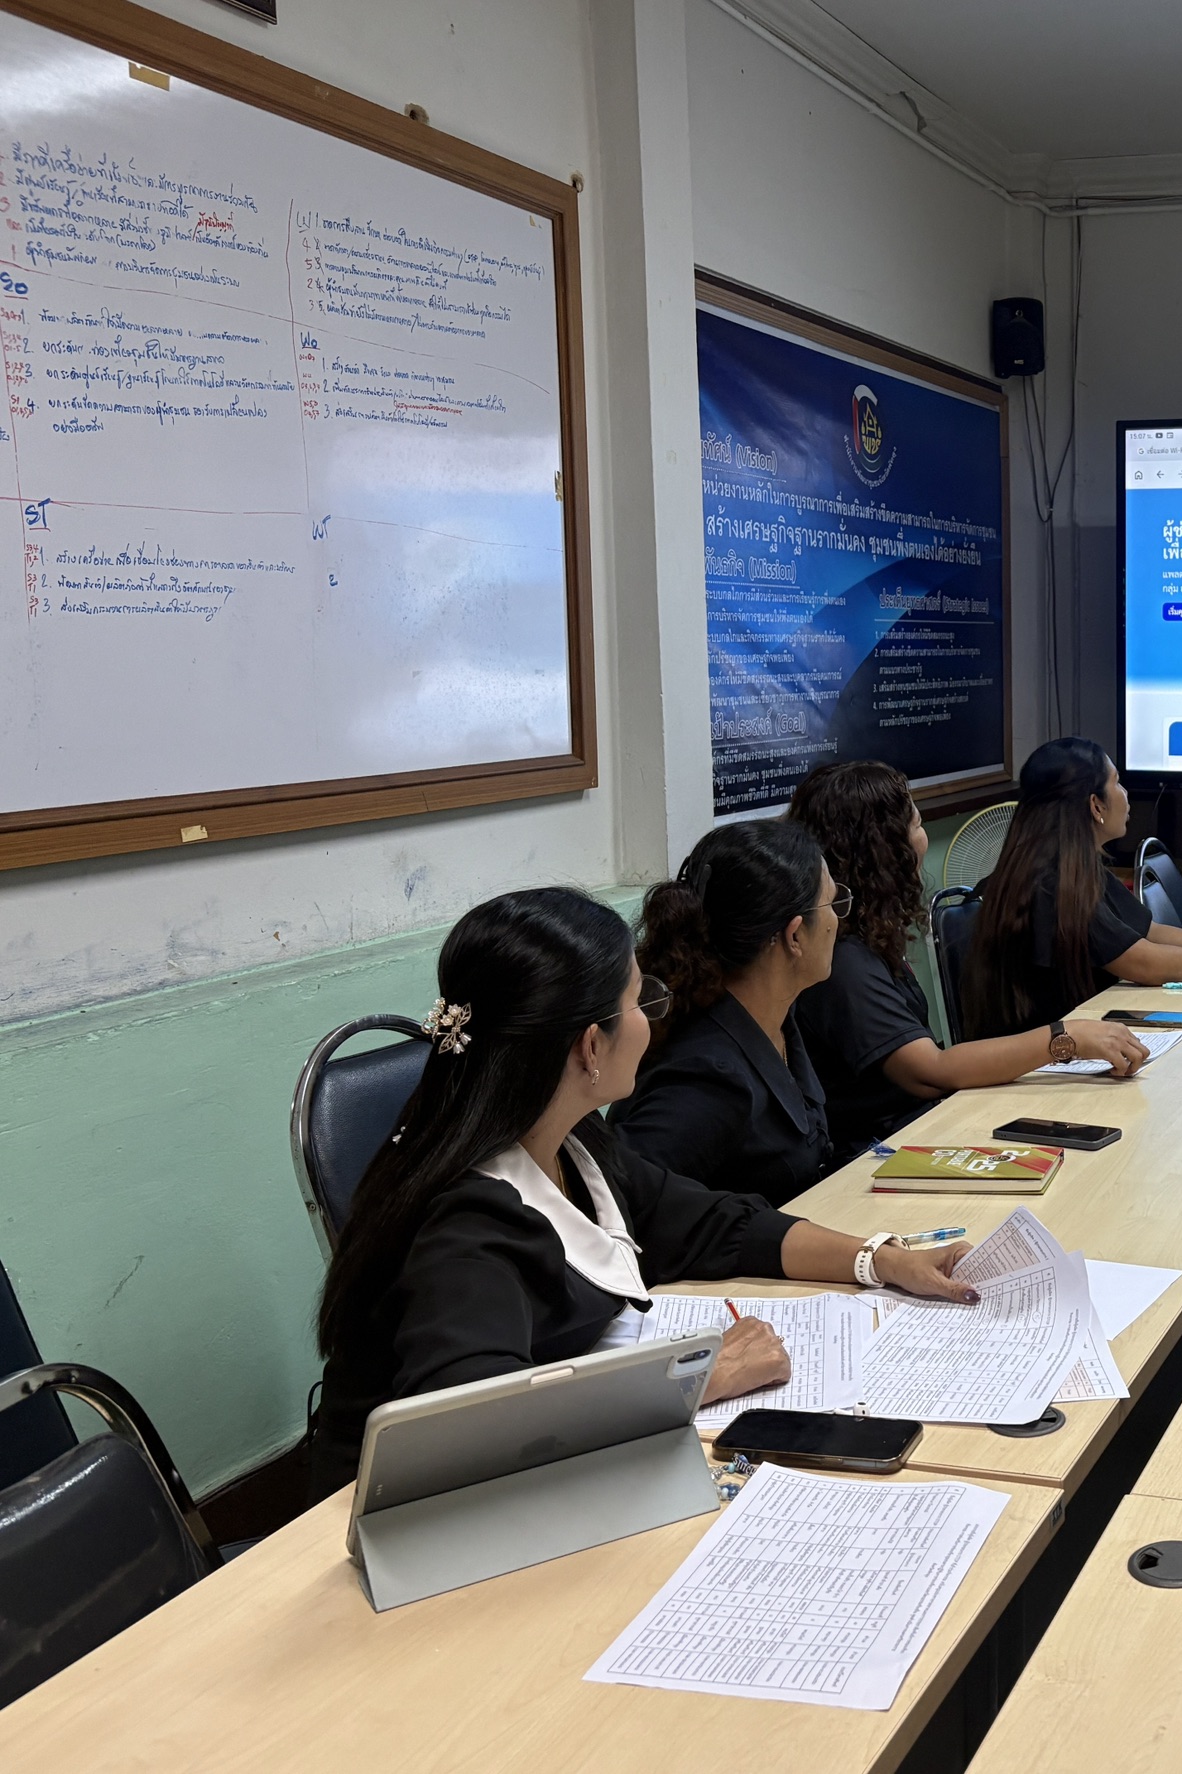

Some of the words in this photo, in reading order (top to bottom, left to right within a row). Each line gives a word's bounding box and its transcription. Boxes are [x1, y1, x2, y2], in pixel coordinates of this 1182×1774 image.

[735, 443, 778, 475] (Vision)
[24, 497, 51, 528] ST
[748, 555, 797, 584] (Mission)
[1162, 583, 1179, 593] กลุ่ม
[774, 711, 807, 737] (Goal)
